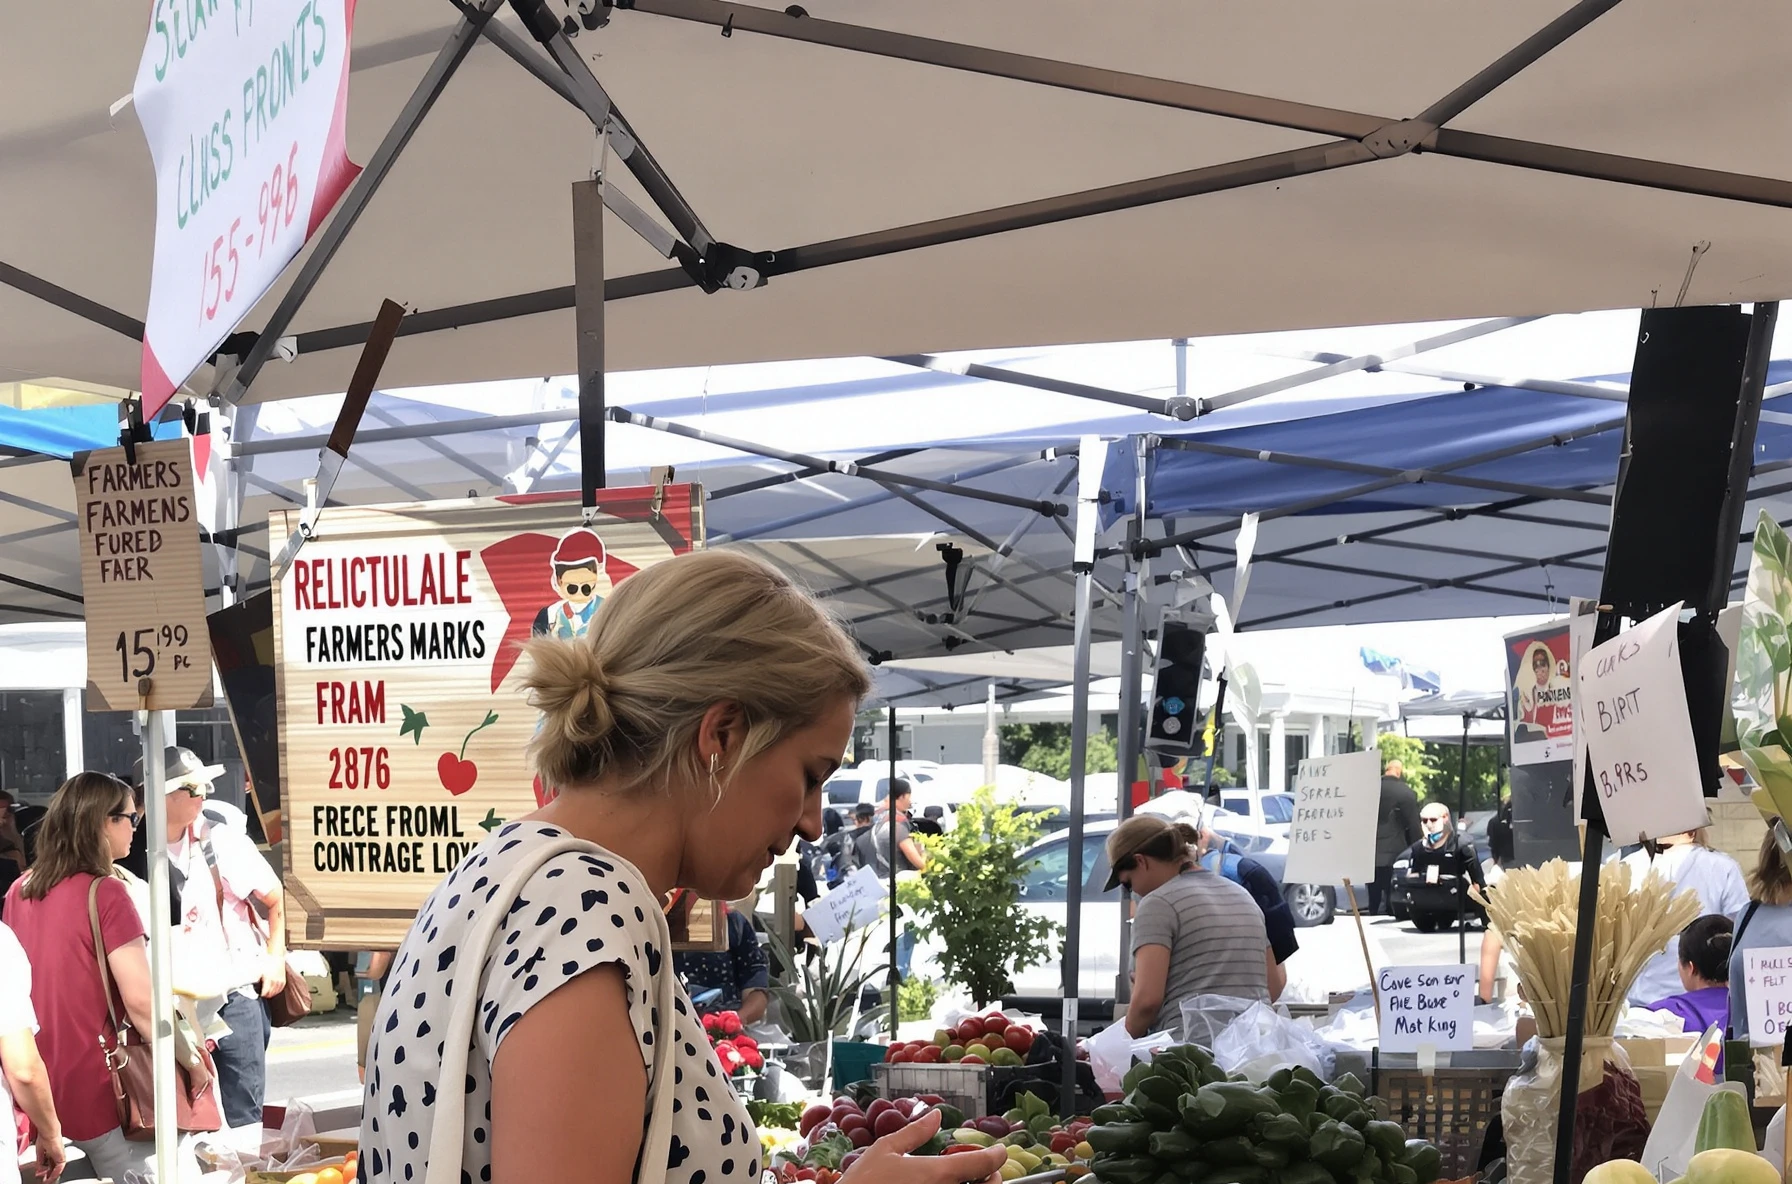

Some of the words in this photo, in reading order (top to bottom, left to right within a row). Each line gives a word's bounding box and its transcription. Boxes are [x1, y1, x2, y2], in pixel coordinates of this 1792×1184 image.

[88, 460, 182, 495] FARMERS
[86, 496, 190, 533] FARMENS
[95, 529, 163, 556] FURED
[100, 556, 154, 583] FAER
[294, 550, 472, 611] RELICTULALE
[306, 623, 404, 663] FARMERS
[410, 620, 486, 660] MARKS
[316, 680, 386, 725] FRAM
[328, 746, 391, 790] 2876
[313, 804, 380, 837] FRECE
[386, 804, 464, 838] FROML
[314, 841, 425, 873] CONTRAGE
